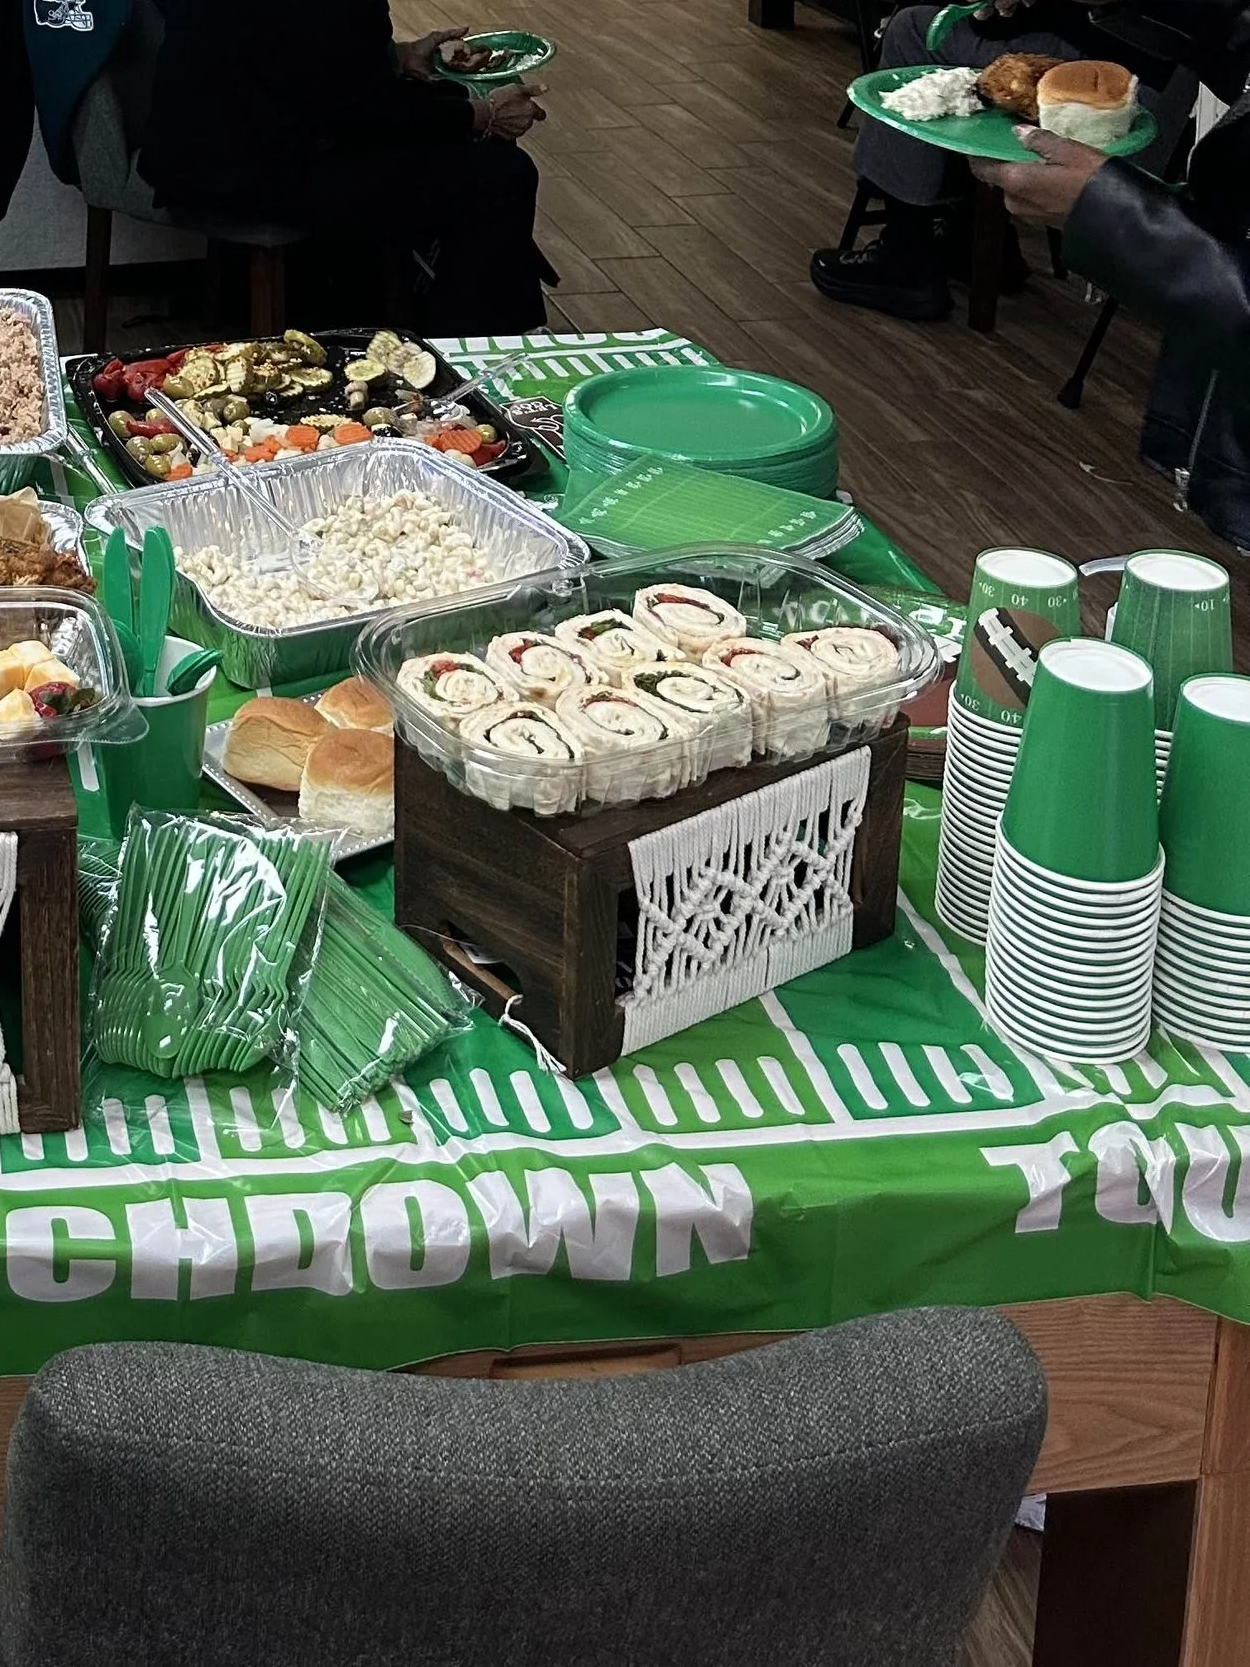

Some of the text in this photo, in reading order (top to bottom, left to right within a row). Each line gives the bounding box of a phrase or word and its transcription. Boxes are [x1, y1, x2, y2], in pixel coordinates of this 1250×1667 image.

[981, 584, 996, 597] 30
[1011, 593, 1030, 606] 40
[1048, 596, 1063, 609] 30
[1201, 600, 1215, 612] 10
[964, 696, 981, 711] 30
